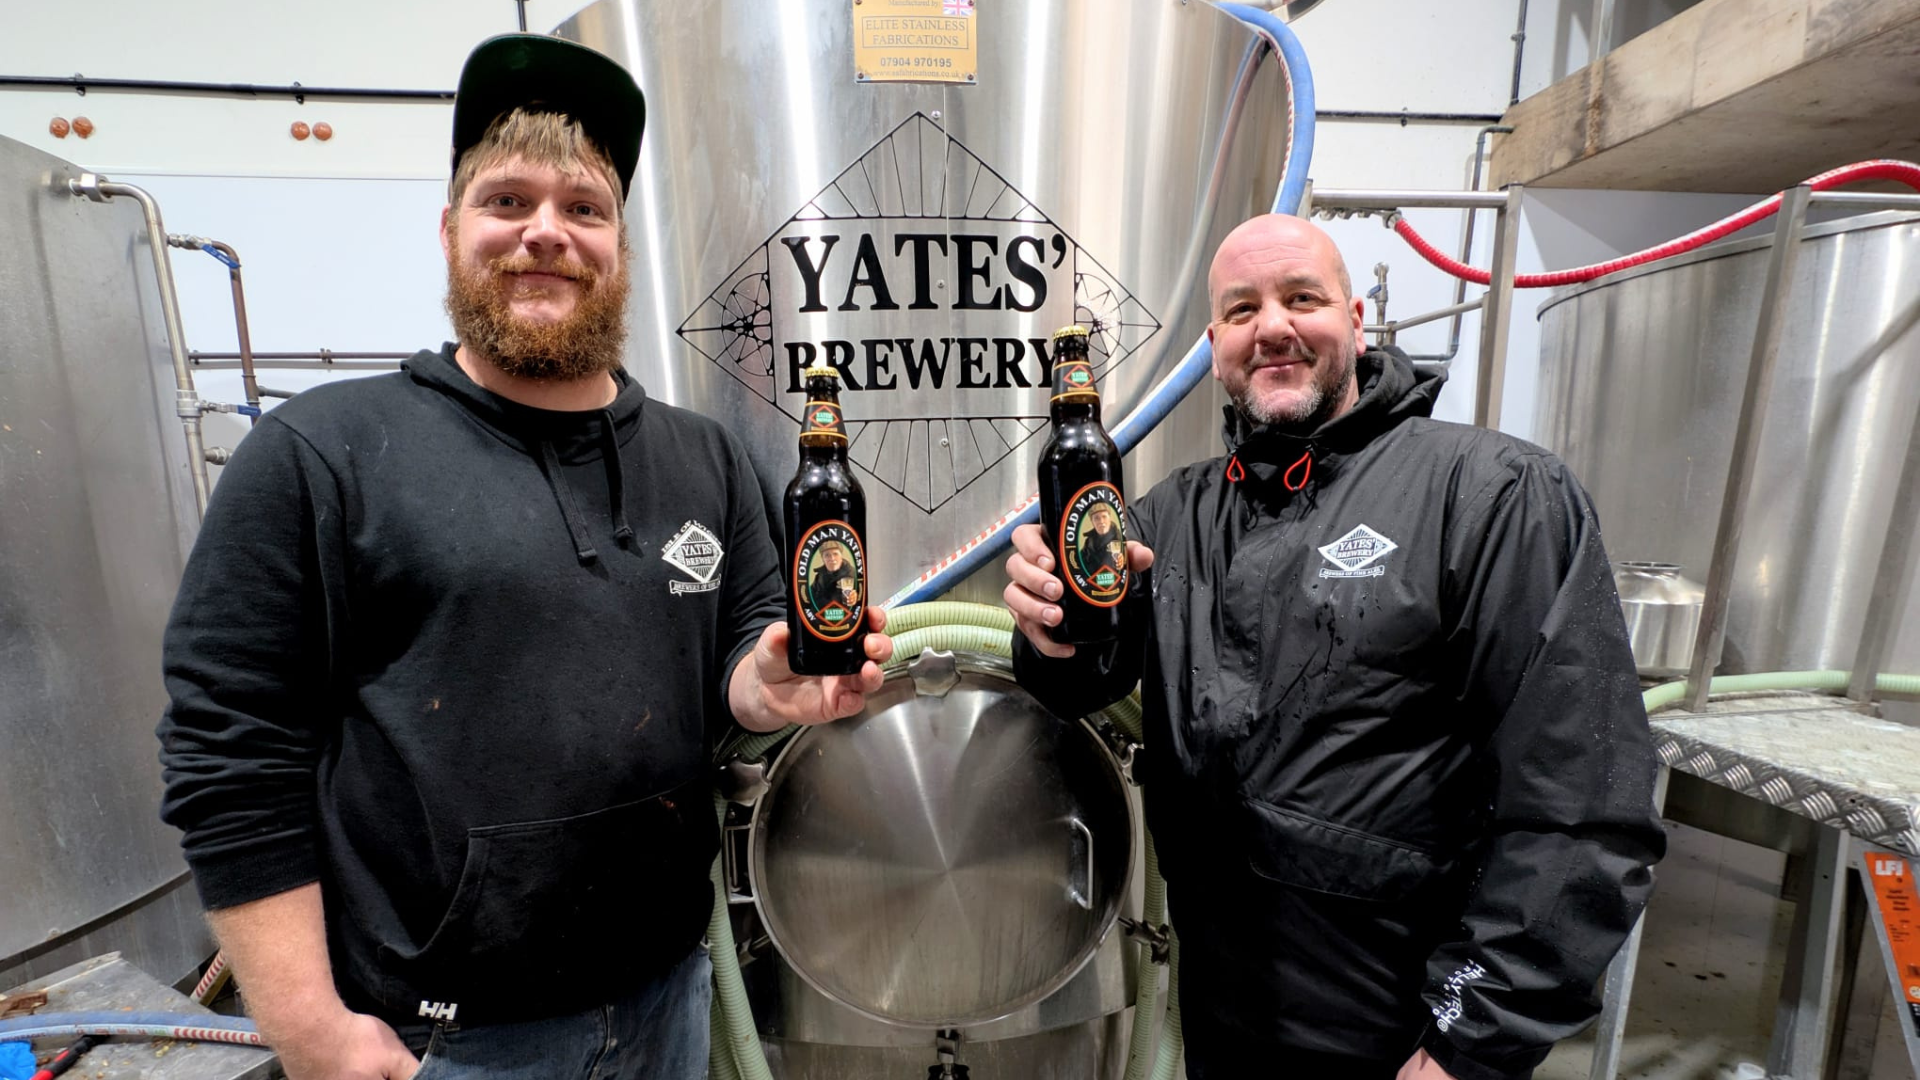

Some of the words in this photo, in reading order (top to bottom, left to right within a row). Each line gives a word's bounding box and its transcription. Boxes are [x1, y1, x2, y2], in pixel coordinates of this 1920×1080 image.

[866, 20, 899, 30] ELITE
[902, 20, 965, 31] STAINLESS
[873, 35, 959, 46] FABRICATIONS
[880, 57, 911, 67] 07904
[914, 57, 952, 68] 970195
[781, 233, 1067, 313] YATES'
[784, 338, 1057, 394] BREWERY
[1066, 512, 1079, 542] OLD
[1075, 489, 1105, 512] MAN
[798, 548, 811, 576] OLD
[807, 528, 838, 548] MAN
[842, 530, 863, 574] YATESY
[1451, 963, 1487, 996] HELLY
